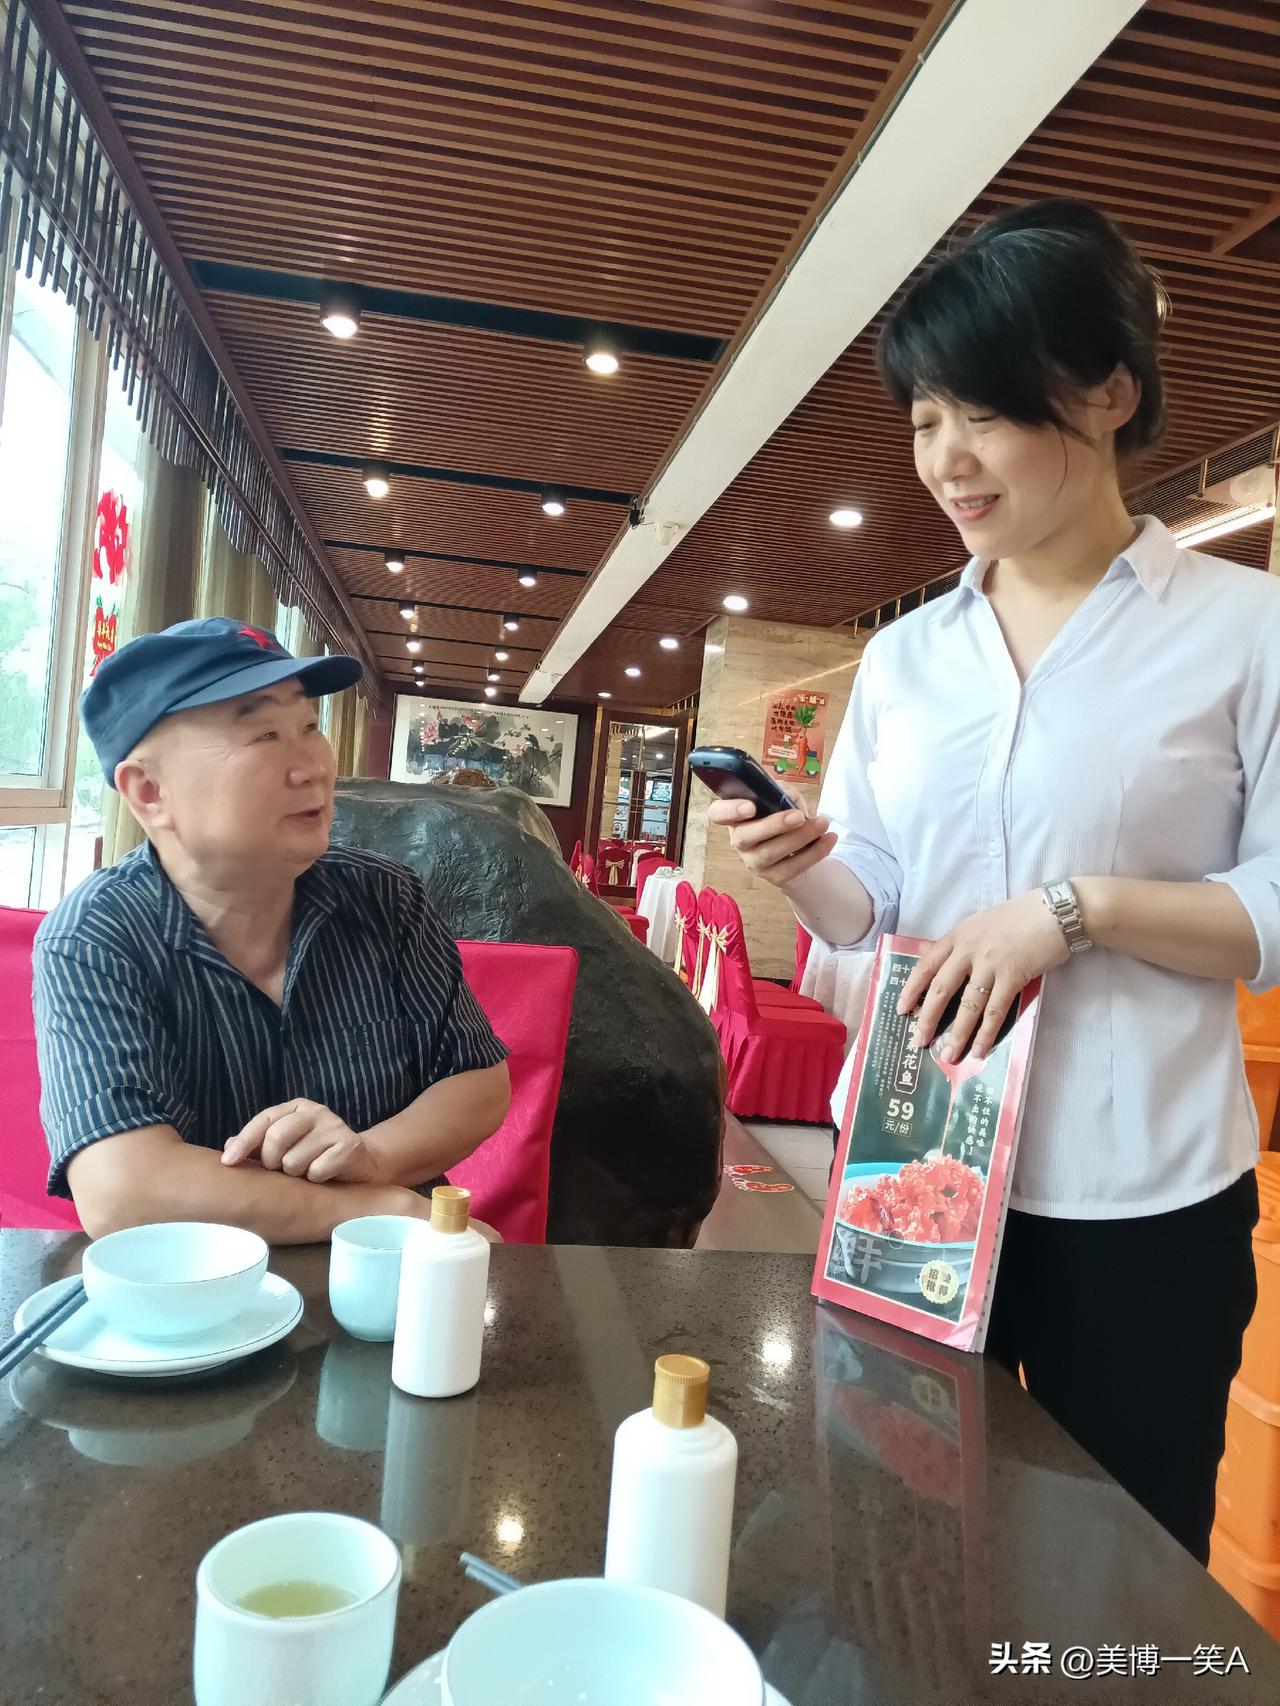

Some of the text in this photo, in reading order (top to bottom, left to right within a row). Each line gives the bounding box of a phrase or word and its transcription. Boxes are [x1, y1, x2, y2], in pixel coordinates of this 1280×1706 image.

[891, 963, 915, 975] 四十
[886, 1098, 915, 1121] 59
[884, 1120, 911, 1135] 元/份
